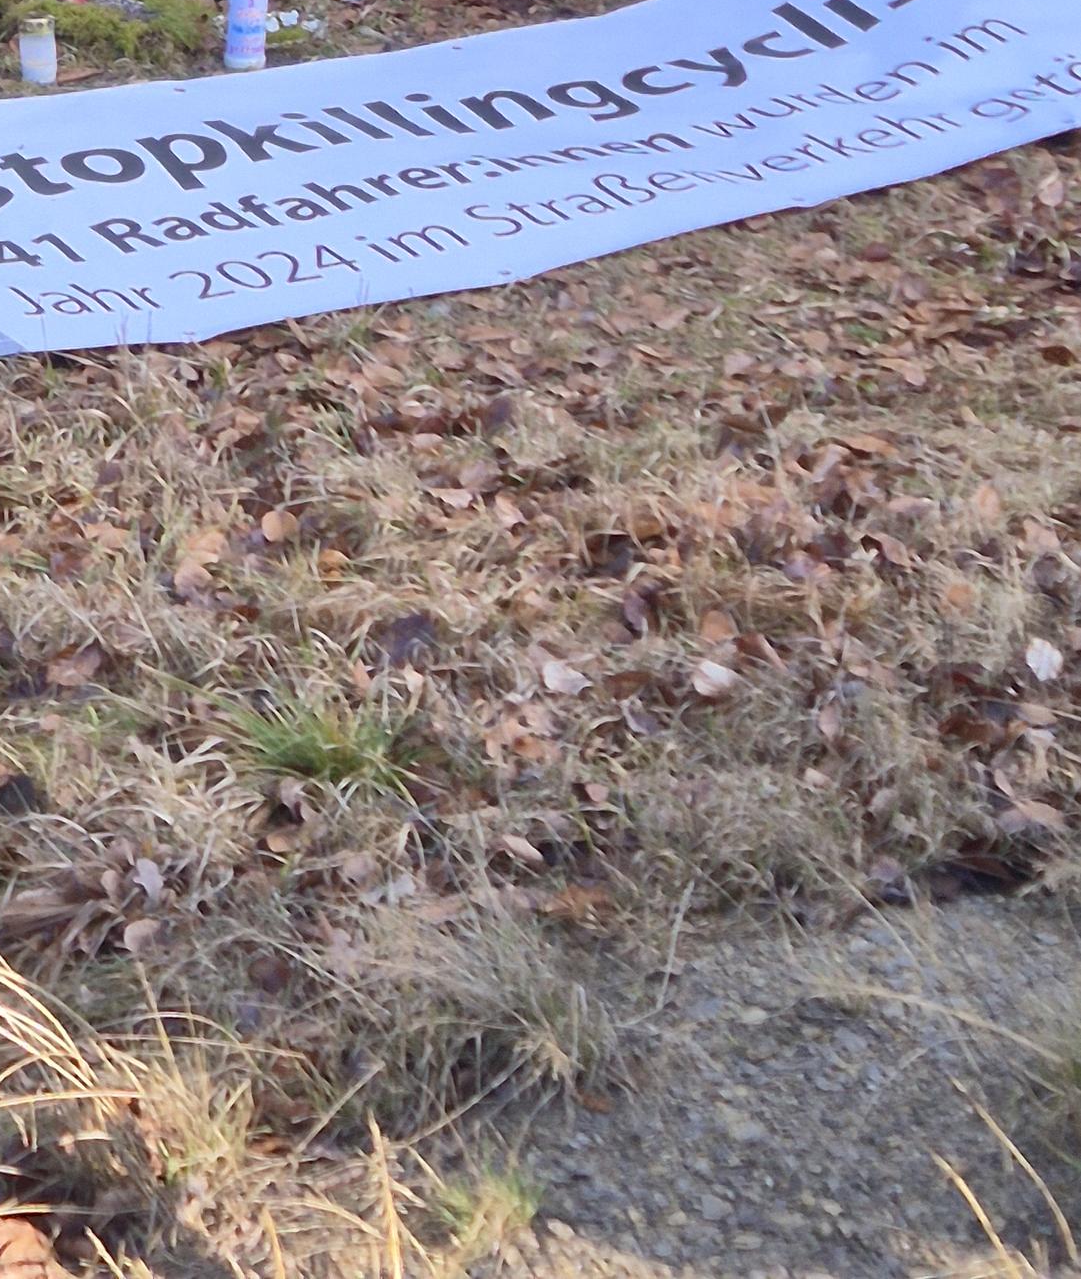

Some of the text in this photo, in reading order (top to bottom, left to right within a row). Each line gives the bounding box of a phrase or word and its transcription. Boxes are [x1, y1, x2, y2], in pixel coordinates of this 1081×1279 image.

[8, 284, 164, 317] Jahr
[169, 243, 361, 300] 2024
[354, 223, 470, 264] im
[464, 111, 962, 238] Straßenverkehr
[90, 131, 694, 254] Radfahrer:innen
[692, 60, 940, 139] wurden
[923, 17, 1028, 61] im
